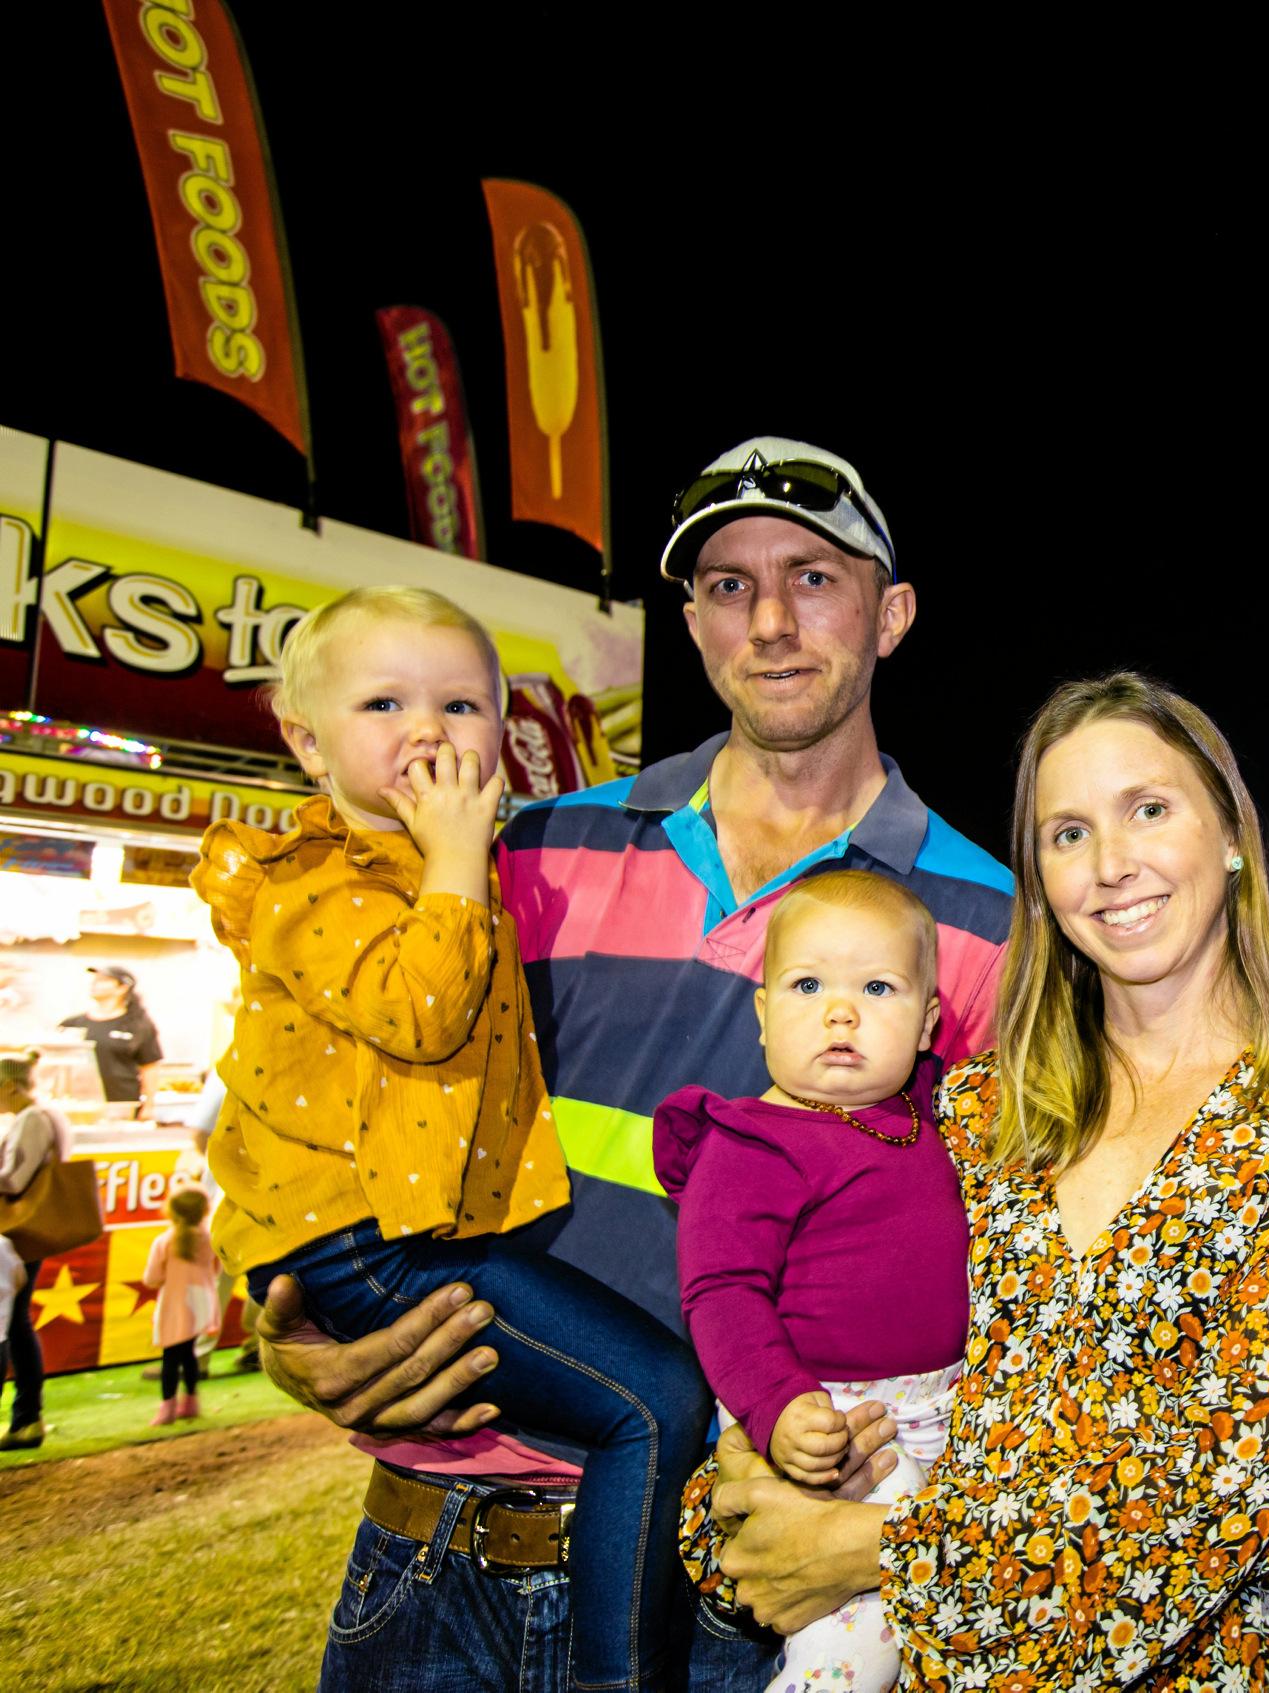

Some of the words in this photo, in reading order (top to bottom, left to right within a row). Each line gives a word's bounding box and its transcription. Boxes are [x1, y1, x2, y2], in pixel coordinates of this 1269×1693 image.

[140, 0, 224, 125] OT
[168, 129, 266, 383] FOODS
[399, 320, 446, 416] HOT
